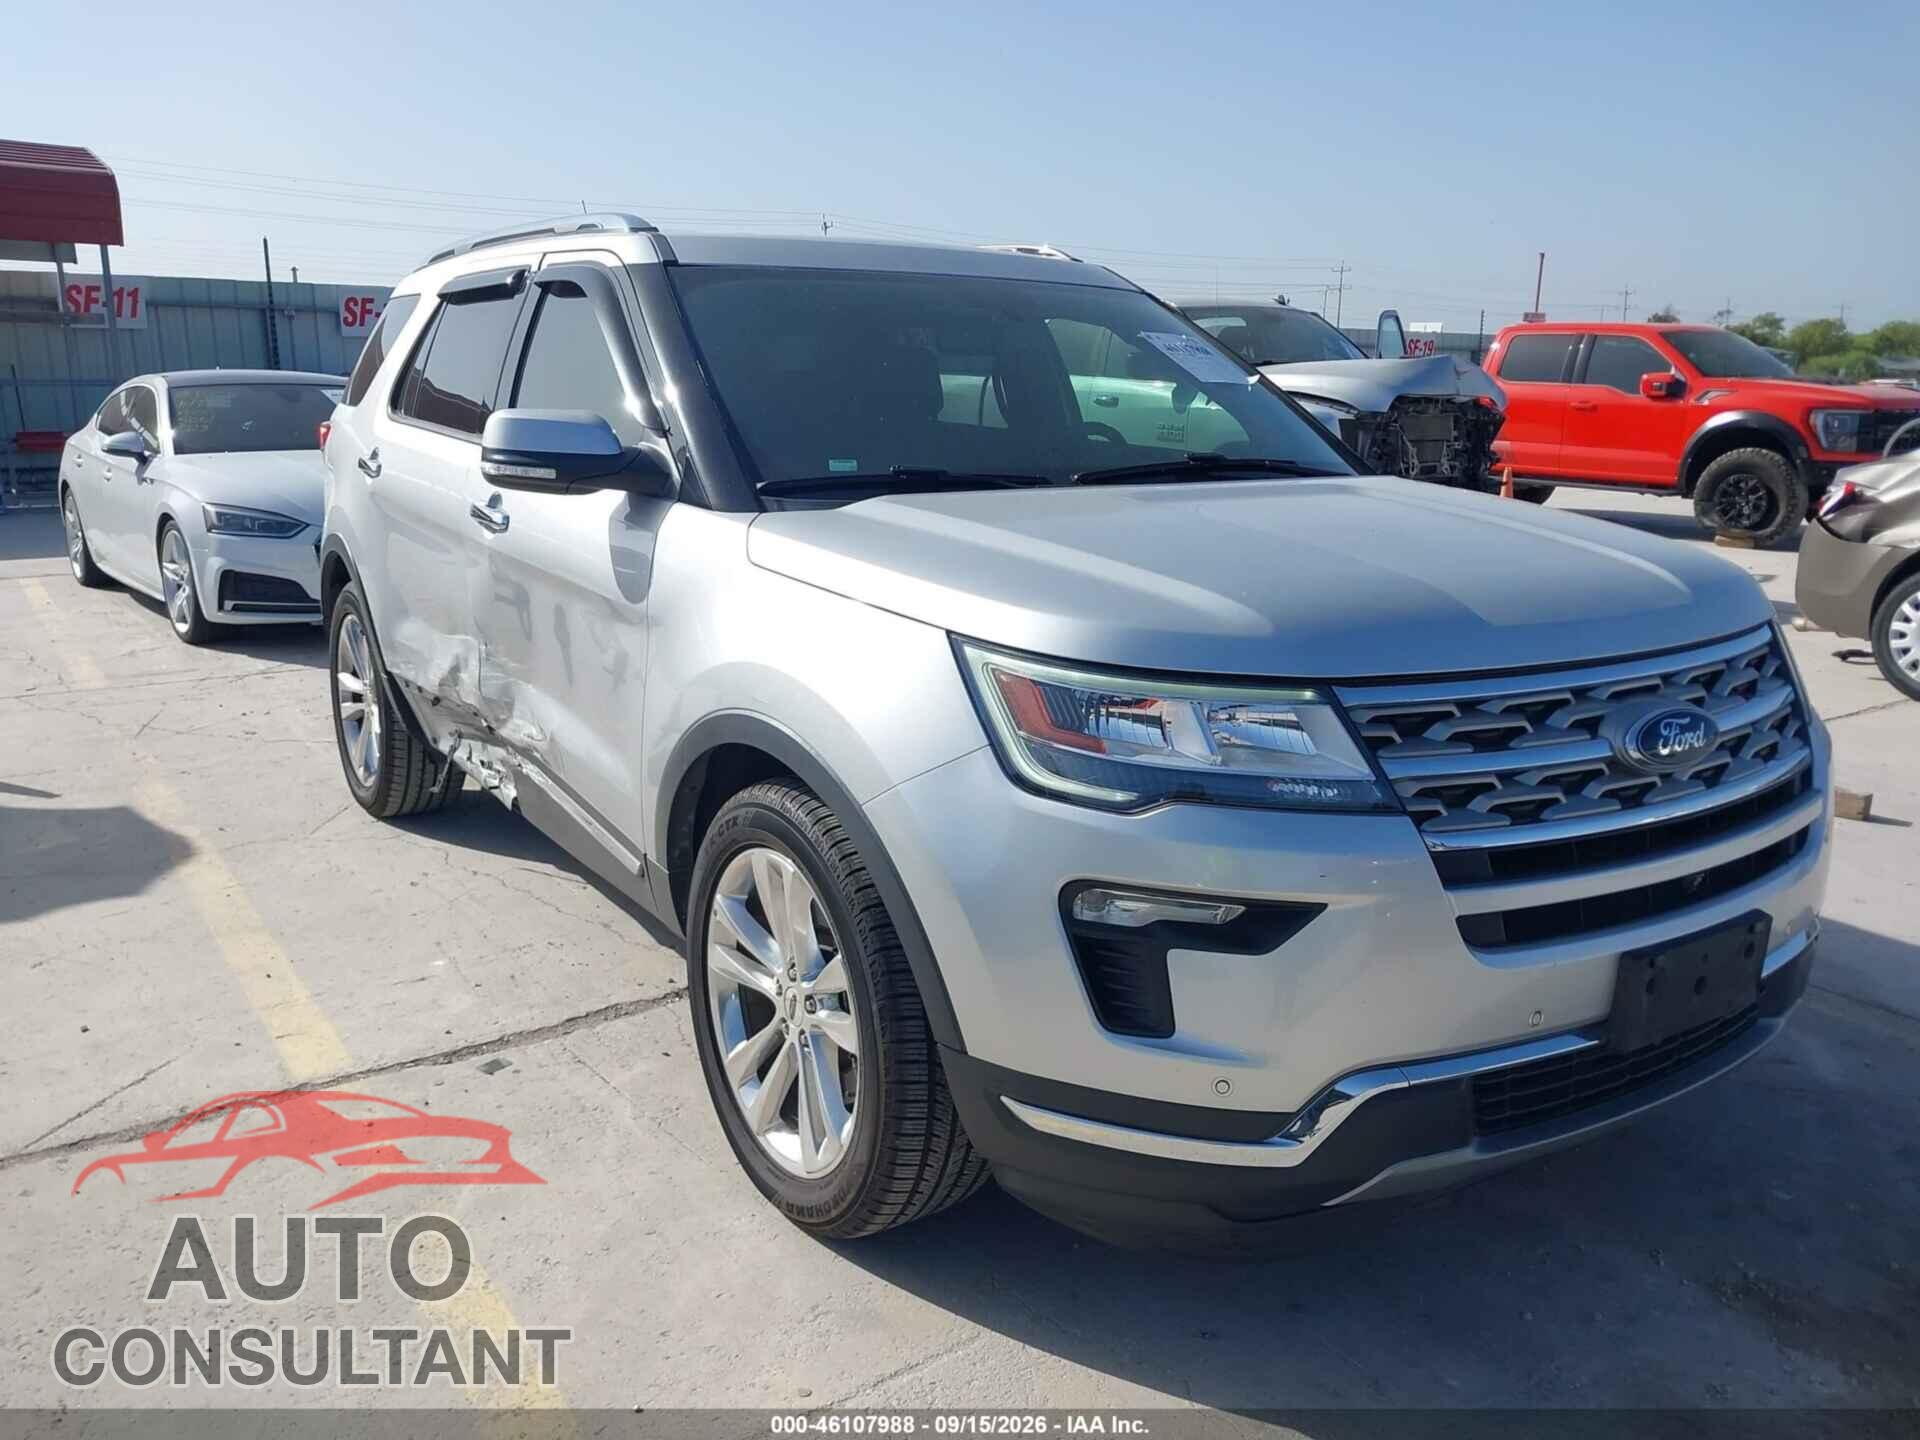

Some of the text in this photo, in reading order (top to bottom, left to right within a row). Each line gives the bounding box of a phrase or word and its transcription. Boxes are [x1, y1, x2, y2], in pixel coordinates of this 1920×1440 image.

[1408, 338, 1434, 356] SF-19
[1657, 716, 1706, 756] Ford
[785, 1184, 854, 1218] OKOHAMA
